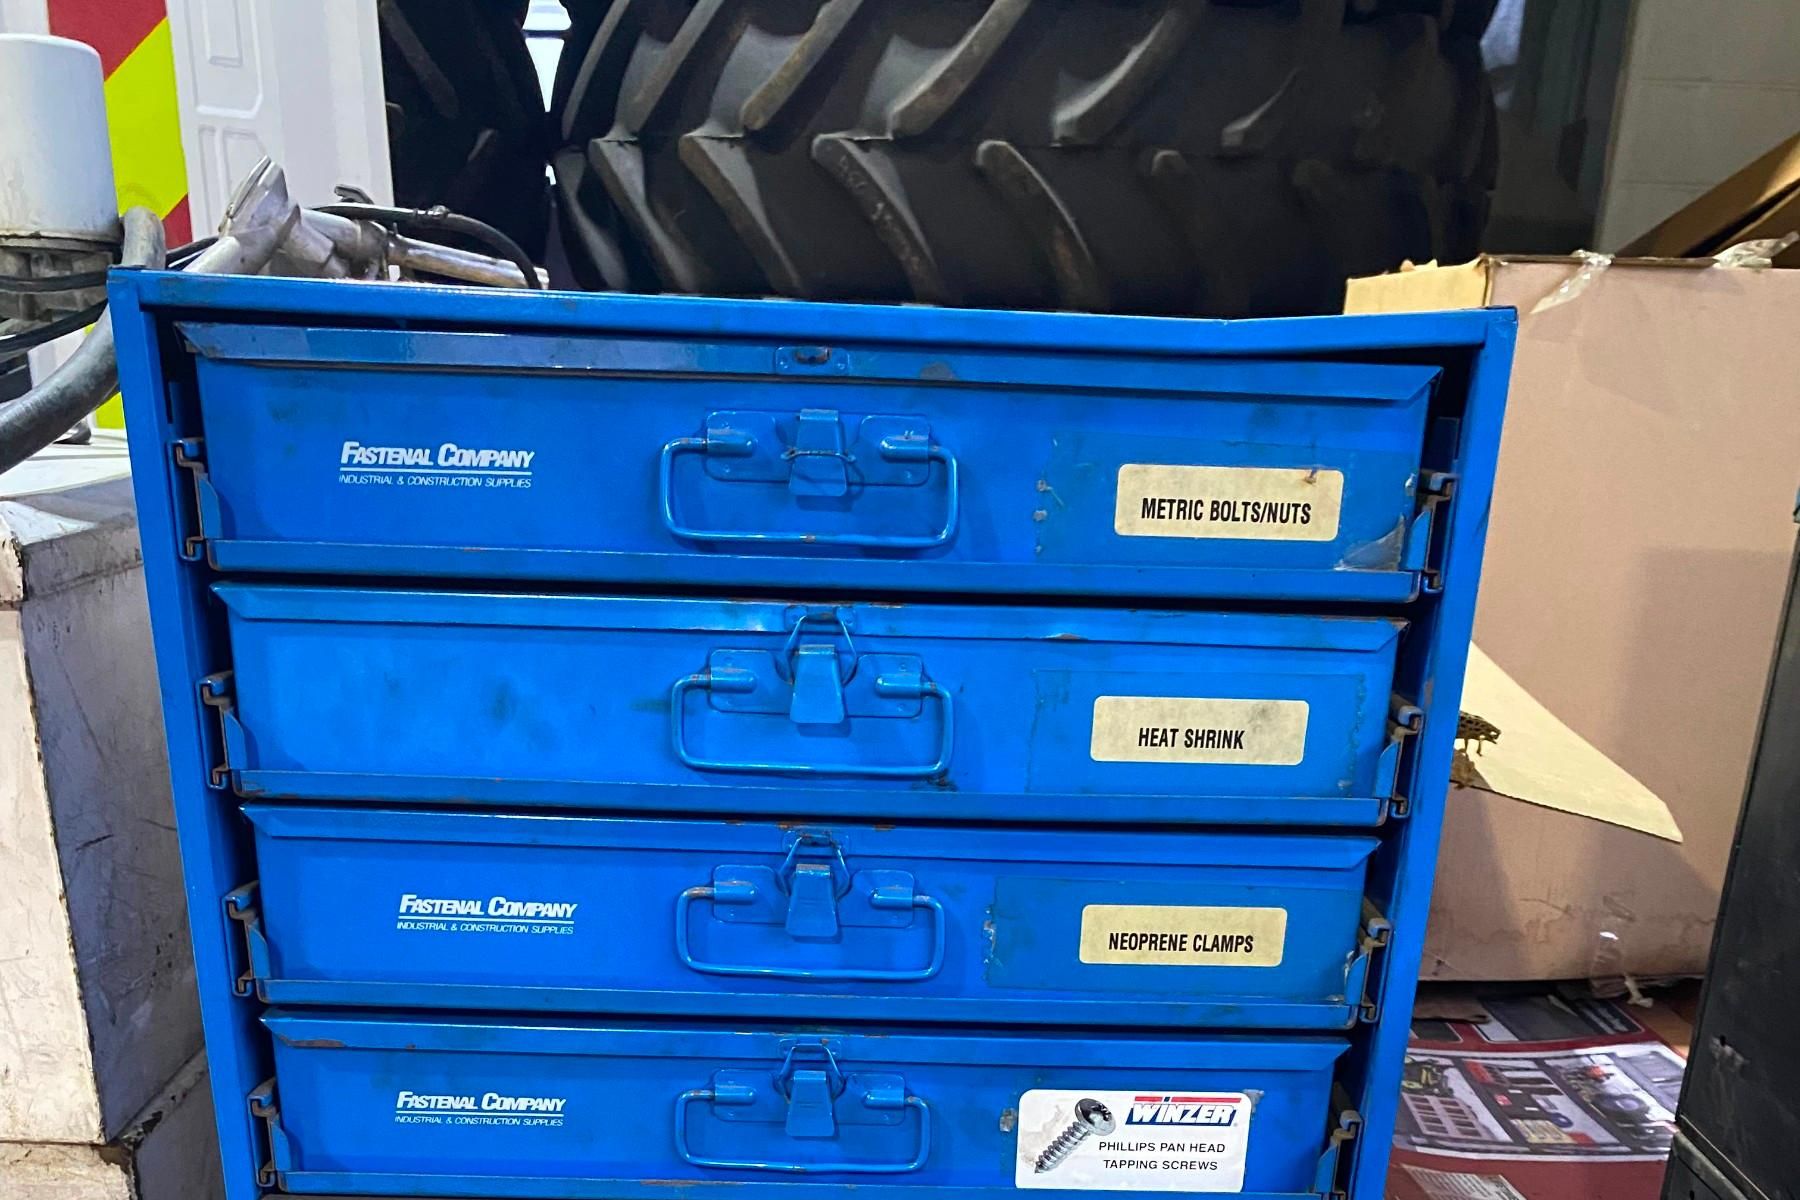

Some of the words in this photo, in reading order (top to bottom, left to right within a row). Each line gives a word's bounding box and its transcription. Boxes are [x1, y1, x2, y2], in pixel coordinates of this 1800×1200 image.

[341, 441, 434, 466] FASTENAL
[437, 443, 535, 468] COMPANY
[339, 474, 393, 486] INDUSTRIAL
[396, 477, 404, 486] &
[407, 476, 482, 487] CONSTRUCTION
[484, 478, 532, 488] SUPPLIES
[1141, 497, 1204, 521] METRIC
[1209, 500, 1312, 525] BOLTS/NUTS
[1138, 727, 1179, 748] HEAT
[1184, 729, 1245, 750] SHRINK
[399, 894, 485, 915] FASTENAL
[487, 896, 578, 918] COMPANY
[396, 921, 449, 931] INDUSTRIAL
[451, 922, 458, 931] &
[460, 923, 528, 933] CONSTRUCTION
[530, 925, 574, 935] SUPPLIES
[1108, 932, 1188, 952] NEOPRENE
[1192, 934, 1254, 953] CLAMPS
[396, 1091, 478, 1109] FASTENAL
[481, 1092, 567, 1111] COMPANY
[394, 1115, 442, 1124] INDUSTRIAL
[445, 1116, 452, 1124] &
[454, 1116, 520, 1125] CONSTRUCTION
[522, 1118, 564, 1127] SUPPLIES
[1099, 1141, 1156, 1152] PHILLIPS
[1160, 1142, 1186, 1152] PAN
[1189, 1143, 1226, 1153] HEAD
[1103, 1160, 1158, 1170] TAPPING
[1162, 1160, 1218, 1170] SCREWS
